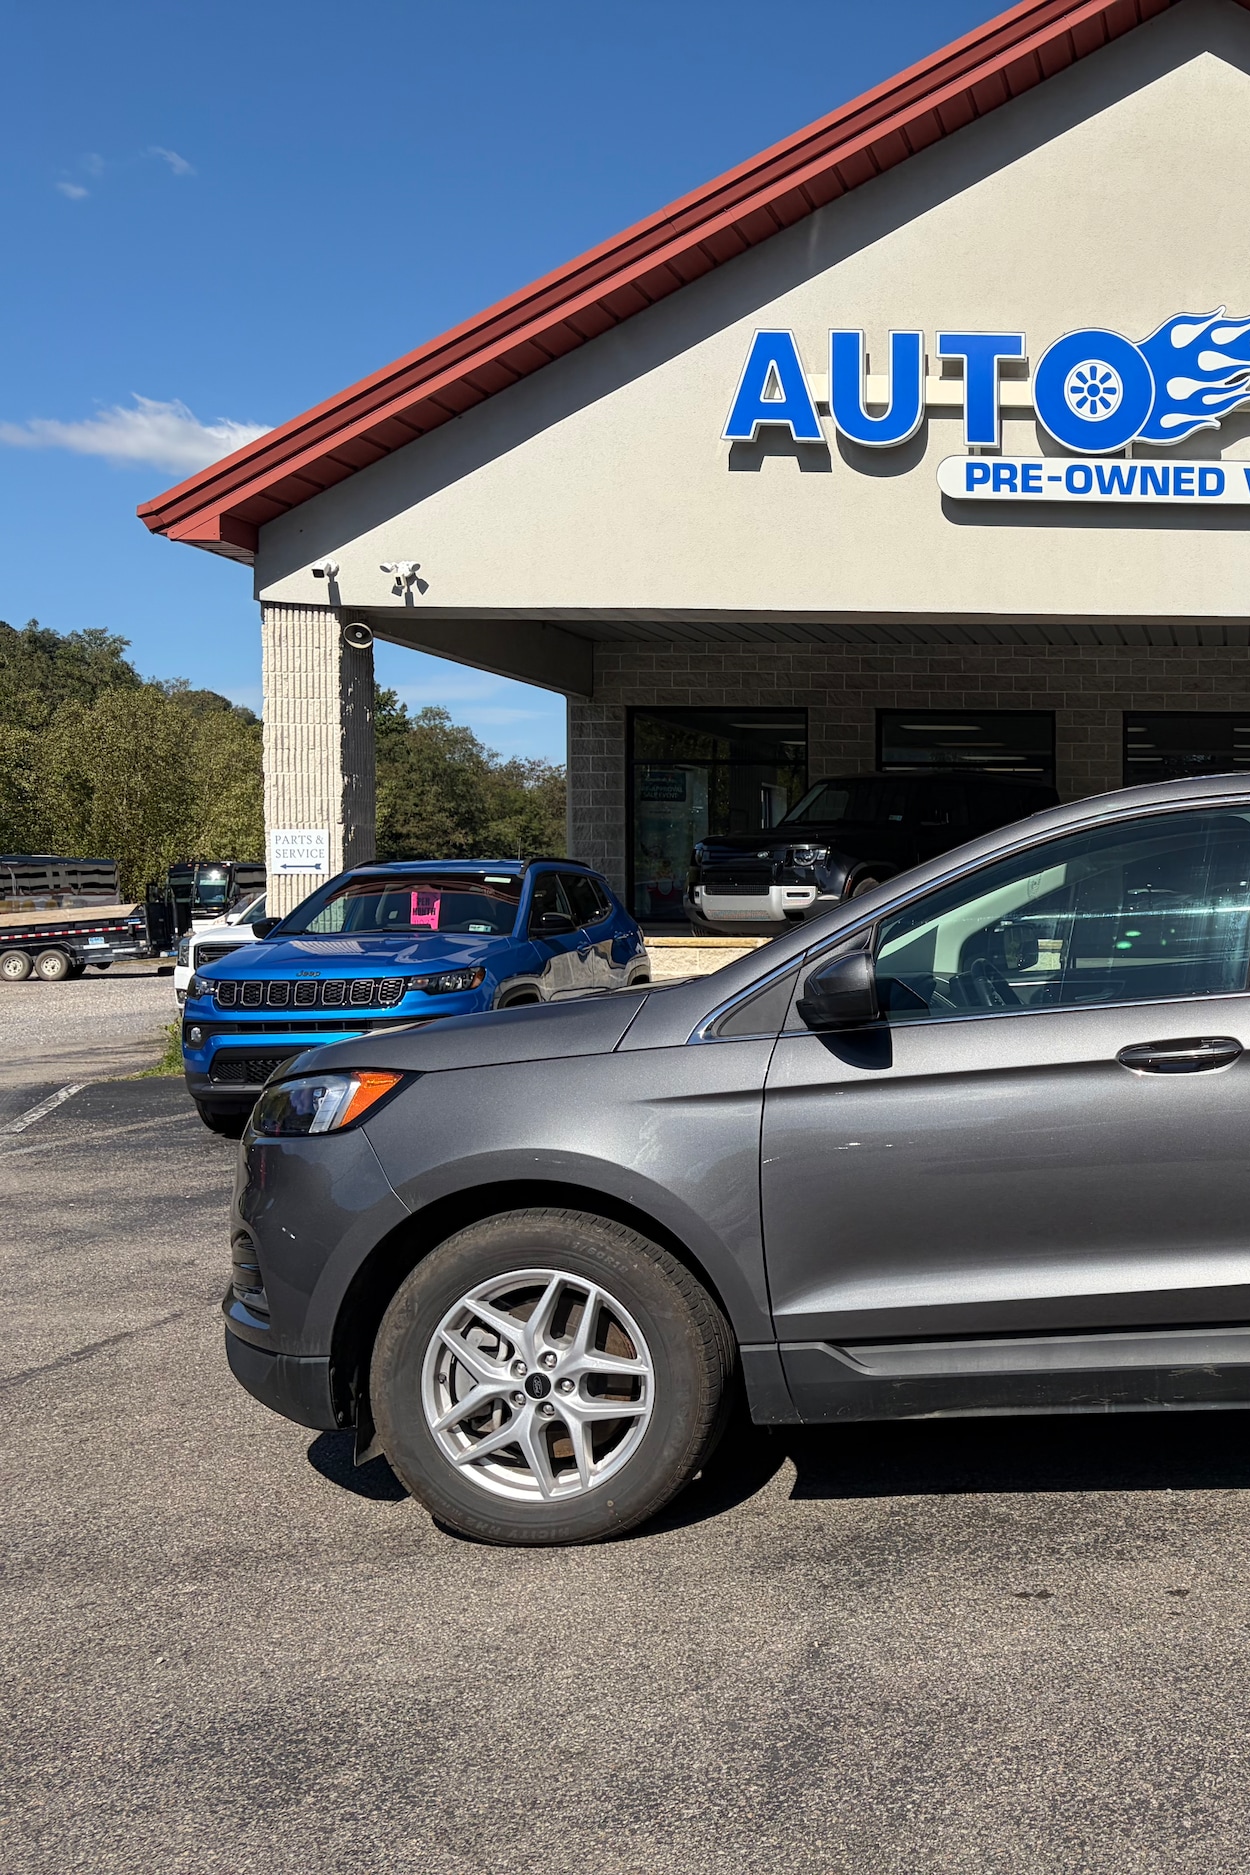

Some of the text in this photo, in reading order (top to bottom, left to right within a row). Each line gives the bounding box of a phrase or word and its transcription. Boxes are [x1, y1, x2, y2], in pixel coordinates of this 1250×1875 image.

[722, 328, 1156, 455] AUTO
[965, 461, 1226, 498] PRE-OWNED
[275, 835, 325, 845] PARTS &
[275, 849, 325, 859] SERVICE
